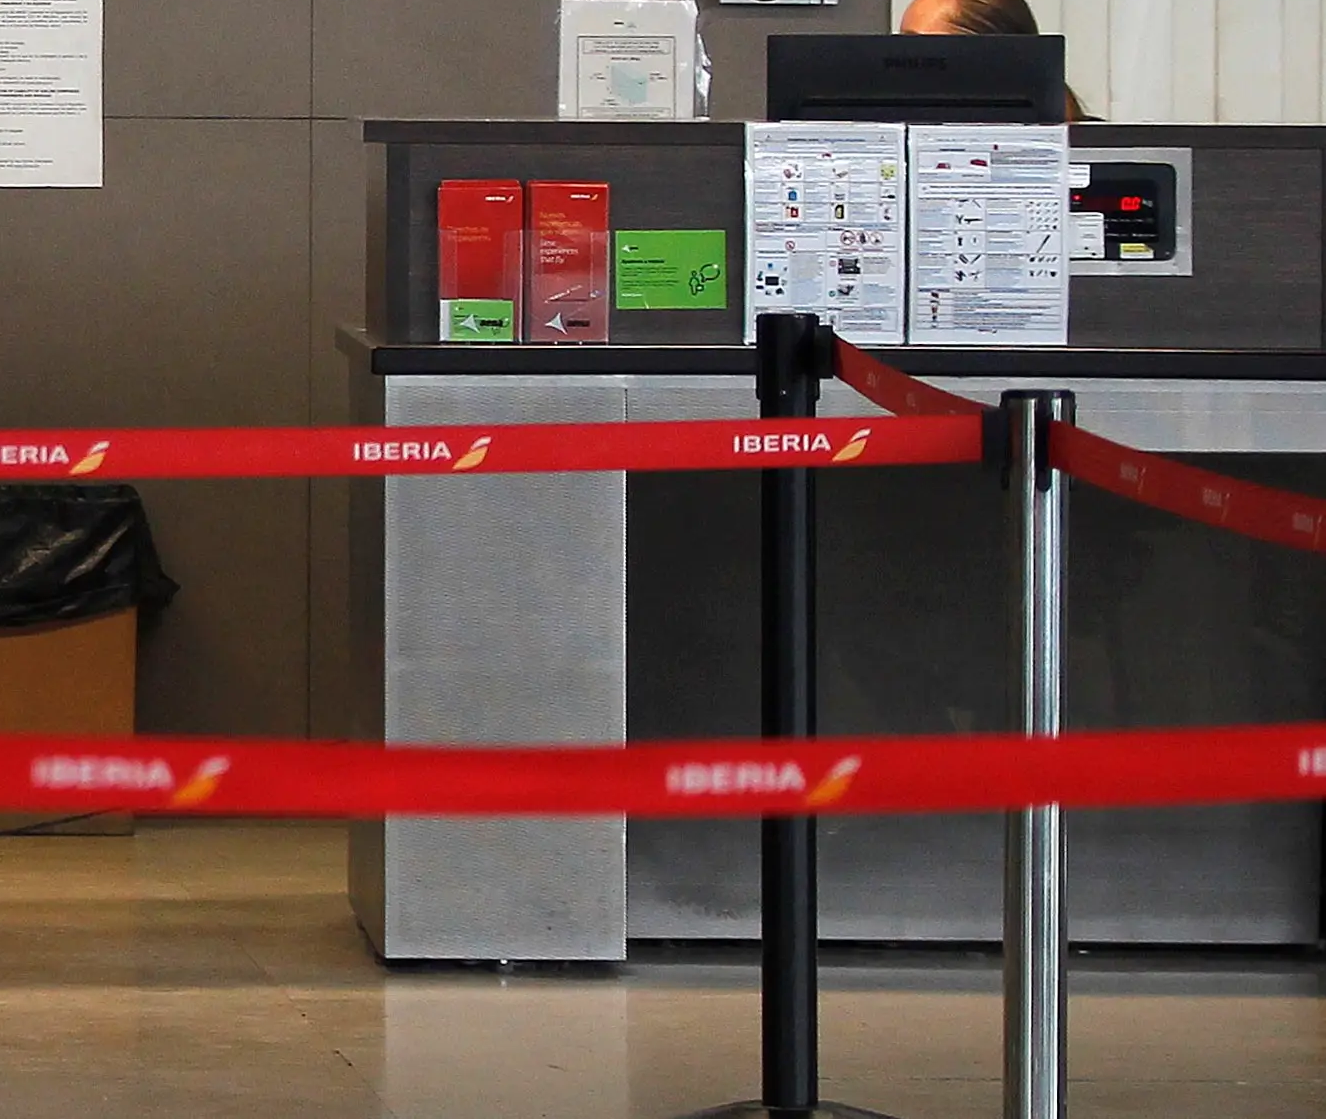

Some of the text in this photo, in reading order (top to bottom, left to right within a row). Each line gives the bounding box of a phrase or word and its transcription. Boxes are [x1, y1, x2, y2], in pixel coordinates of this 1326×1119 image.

[353, 440, 453, 462] IBERIA
[732, 432, 832, 454] IBERIA
[30, 754, 175, 790] IBERIA
[664, 761, 807, 795] IBERIA
